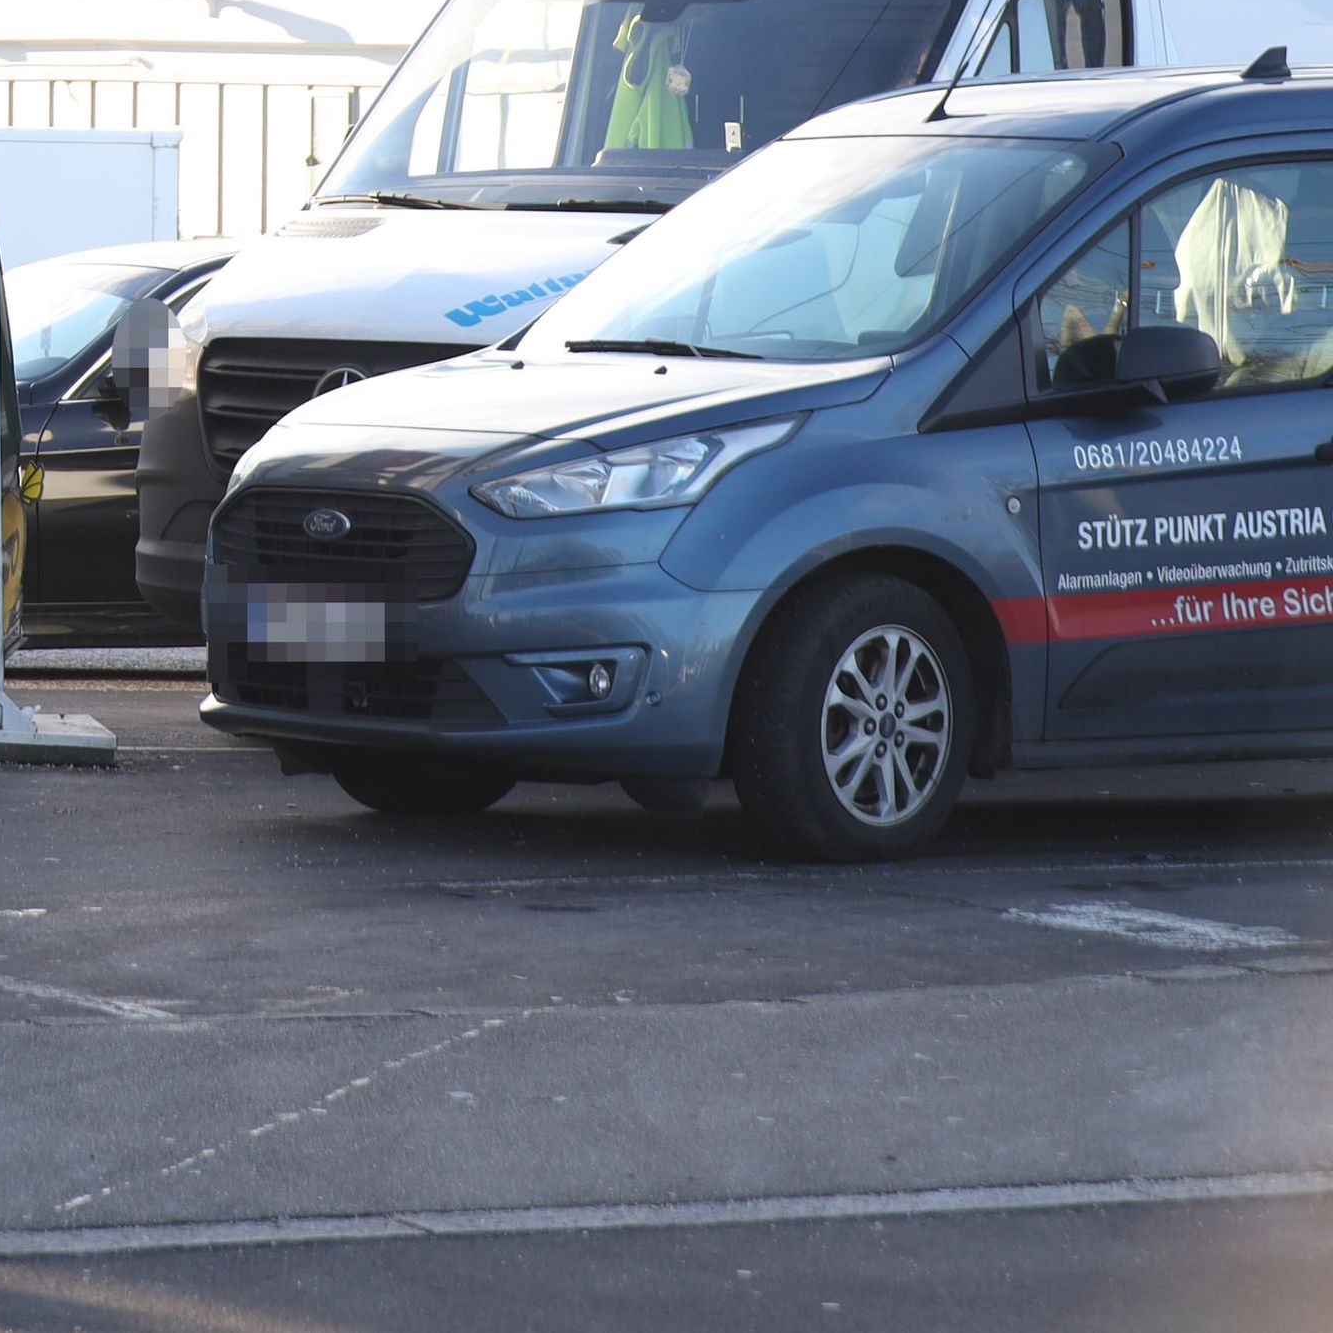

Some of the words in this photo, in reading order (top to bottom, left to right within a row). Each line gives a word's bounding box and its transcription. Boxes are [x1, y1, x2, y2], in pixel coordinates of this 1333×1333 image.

[1073, 435, 1243, 470] 0681/20484224
[1078, 513, 1149, 550] STÜTZ
[1154, 513, 1227, 545] PUNKT
[1233, 506, 1327, 540] AUSTRIA
[1057, 570, 1143, 591] Alarmanlagen
[1156, 559, 1272, 584] Videoüberwachung
[1221, 591, 1276, 620] Ihre
